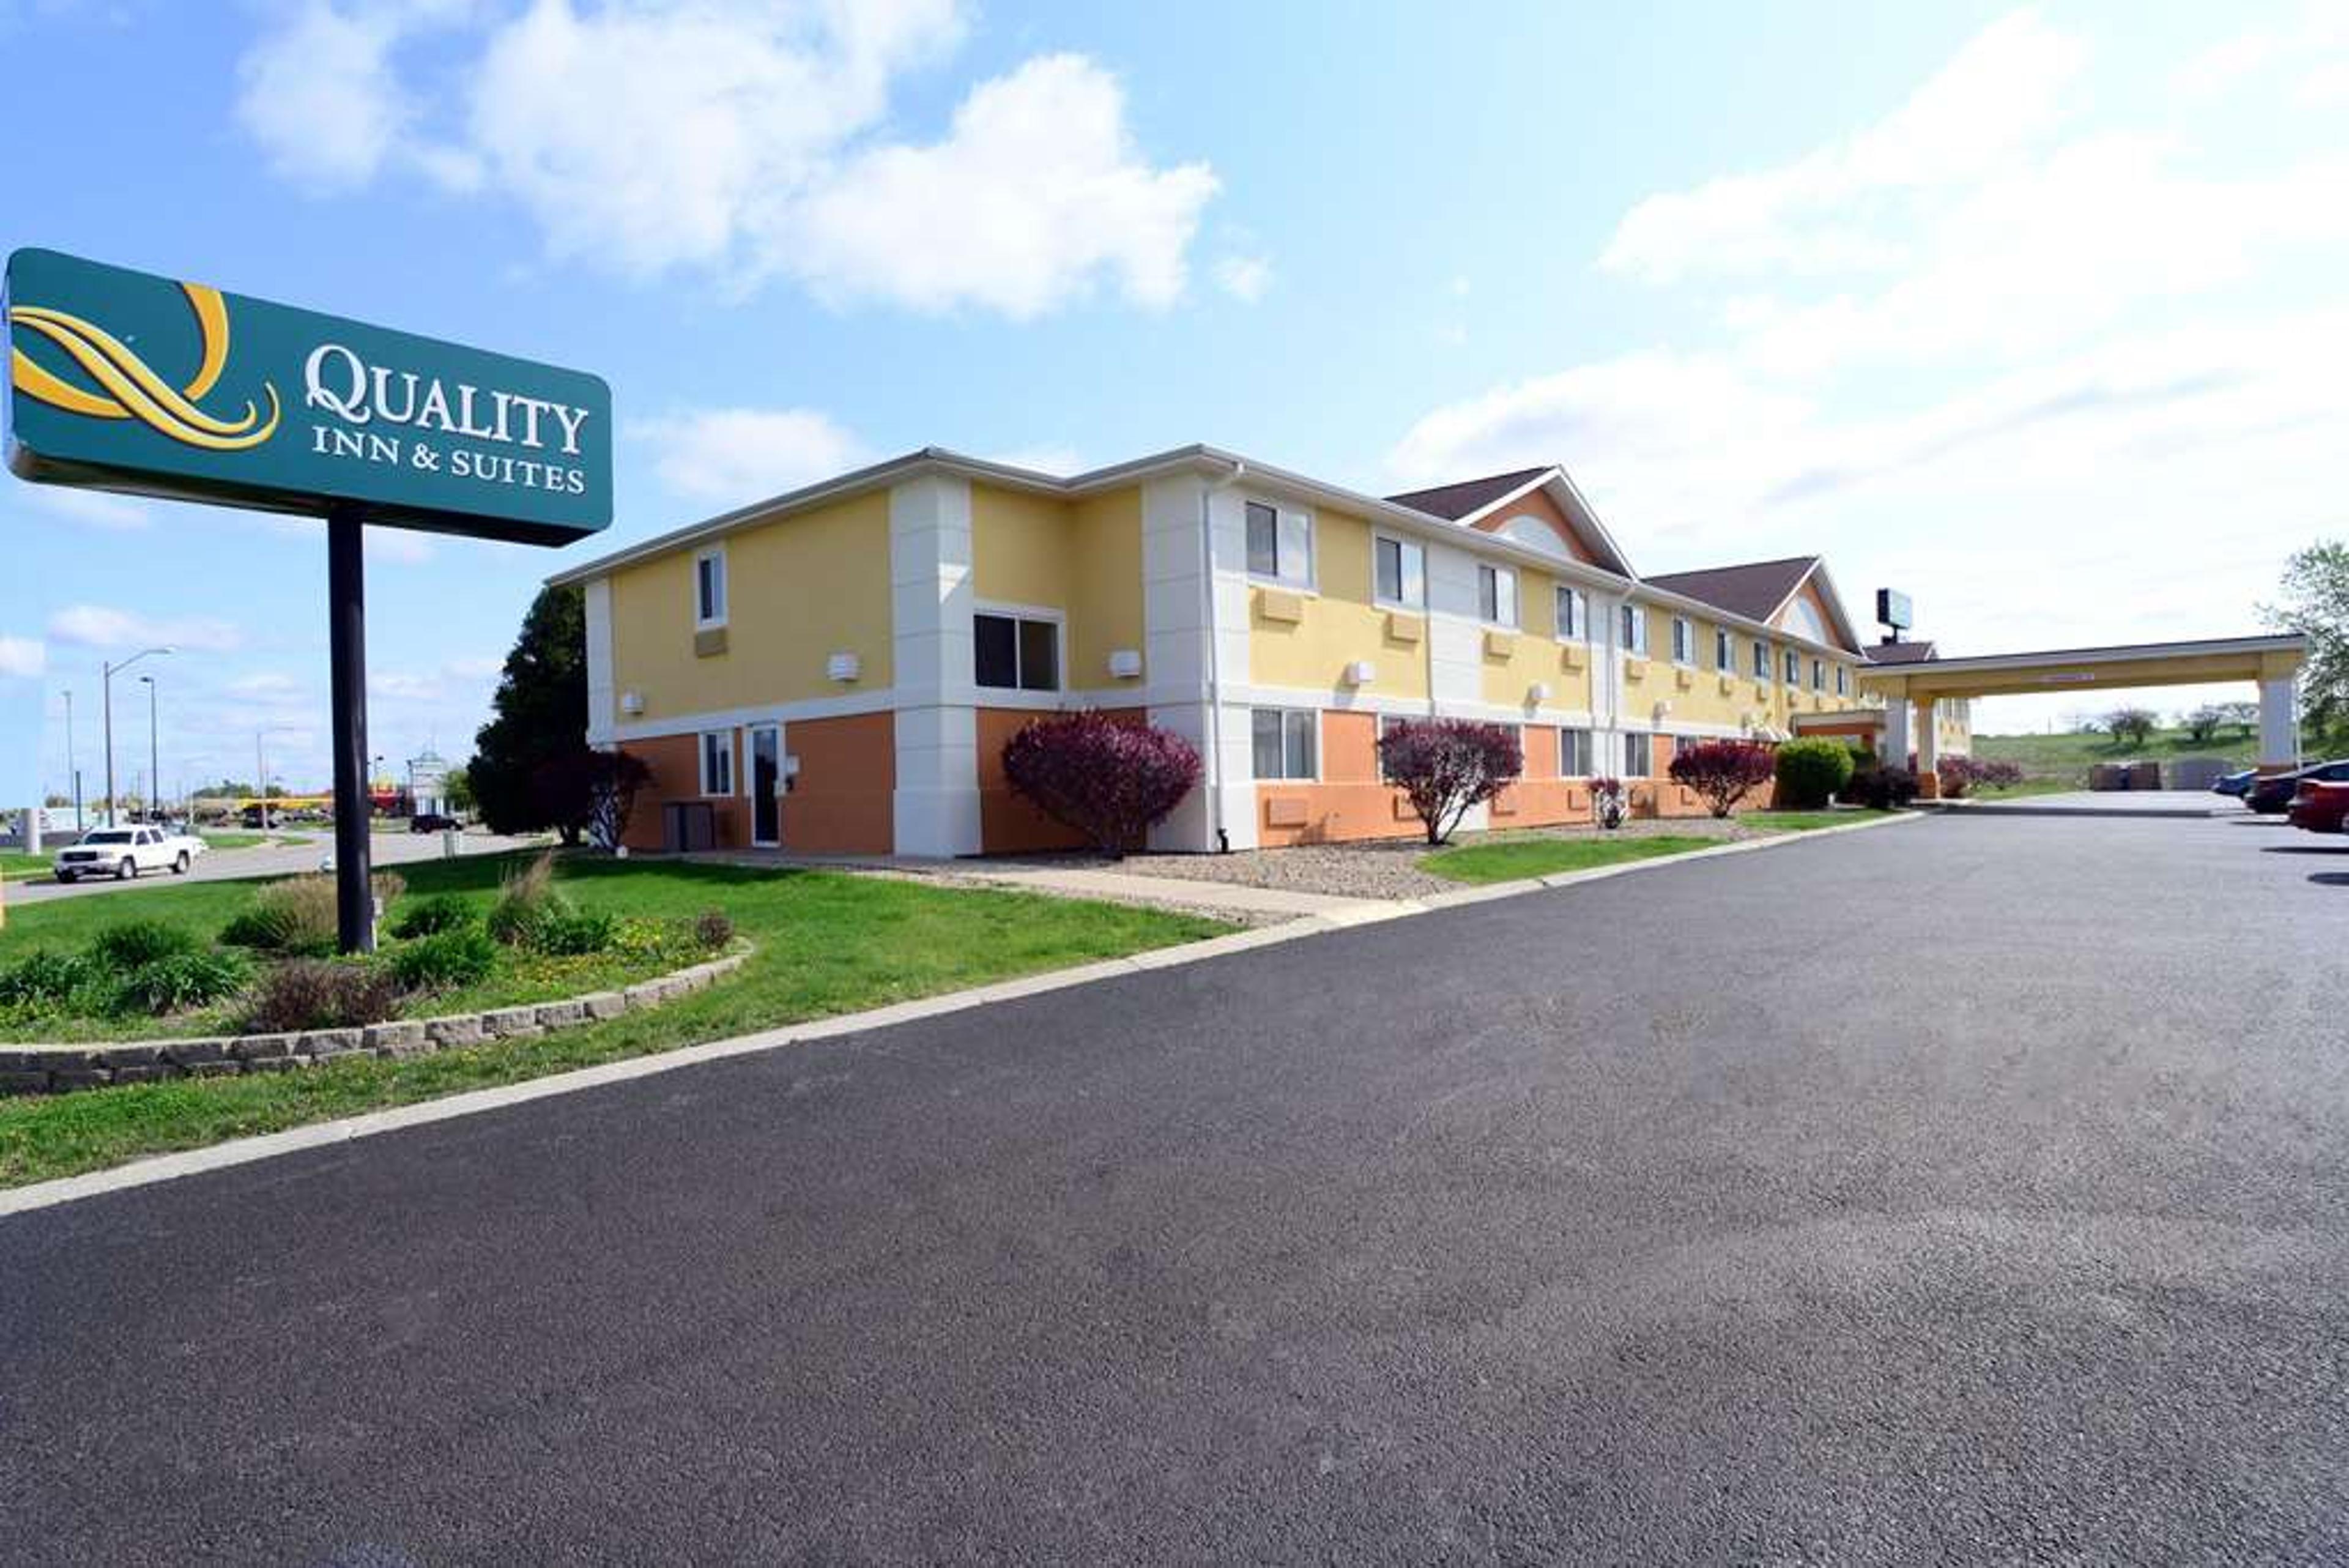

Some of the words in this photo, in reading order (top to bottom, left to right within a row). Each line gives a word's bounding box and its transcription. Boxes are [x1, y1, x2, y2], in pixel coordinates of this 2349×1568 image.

[305, 343, 589, 455] QUALITY
[312, 426, 400, 464] INN
[412, 442, 440, 470] &
[451, 450, 585, 494] SUITES
